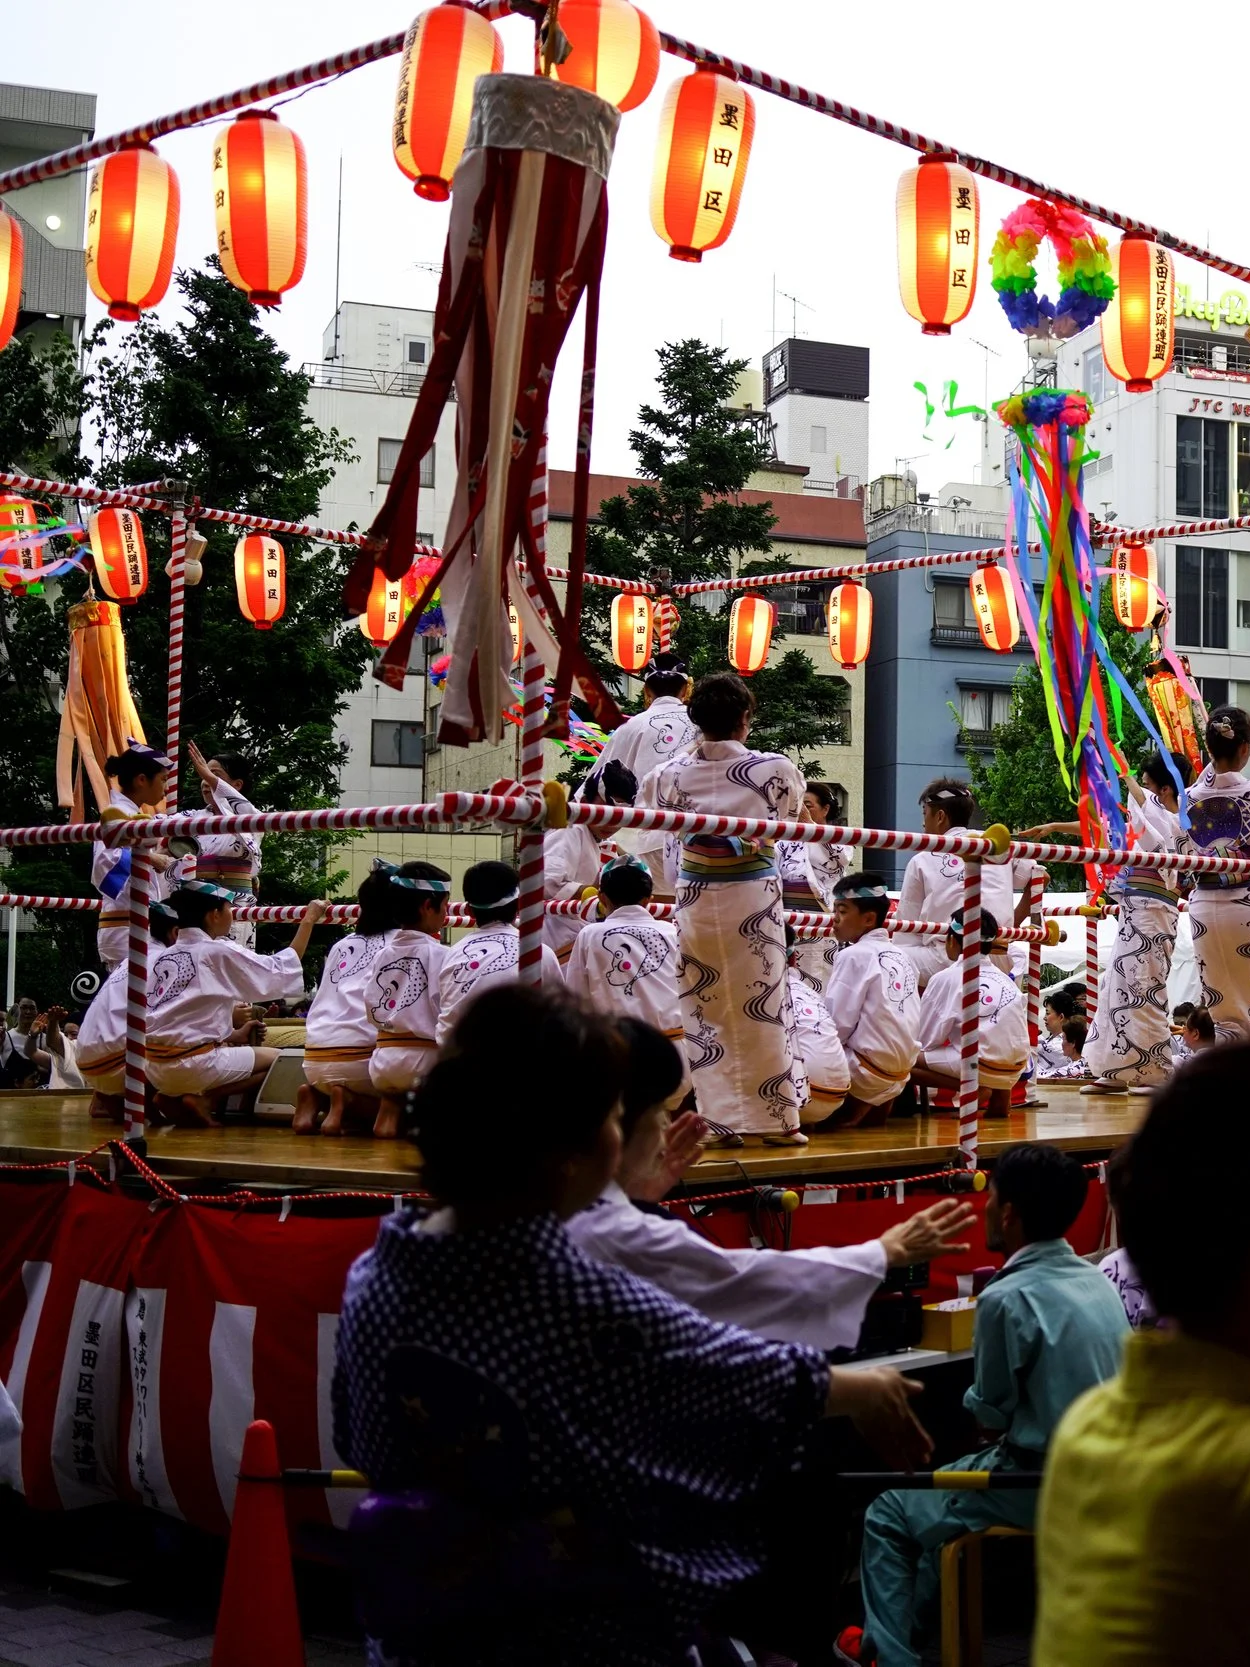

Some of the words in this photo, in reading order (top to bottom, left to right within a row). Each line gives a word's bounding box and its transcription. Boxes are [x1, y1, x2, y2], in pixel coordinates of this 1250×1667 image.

[702, 103, 738, 214] 墨田区
[213, 147, 229, 254] 墨田区
[952, 187, 971, 288] 墨田区
[1189, 398, 1223, 413] JTC
[267, 549, 278, 600] 墨田区
[388, 579, 399, 623] 田区
[975, 584, 993, 634] 墨田区
[635, 607, 646, 654] 墨田区
